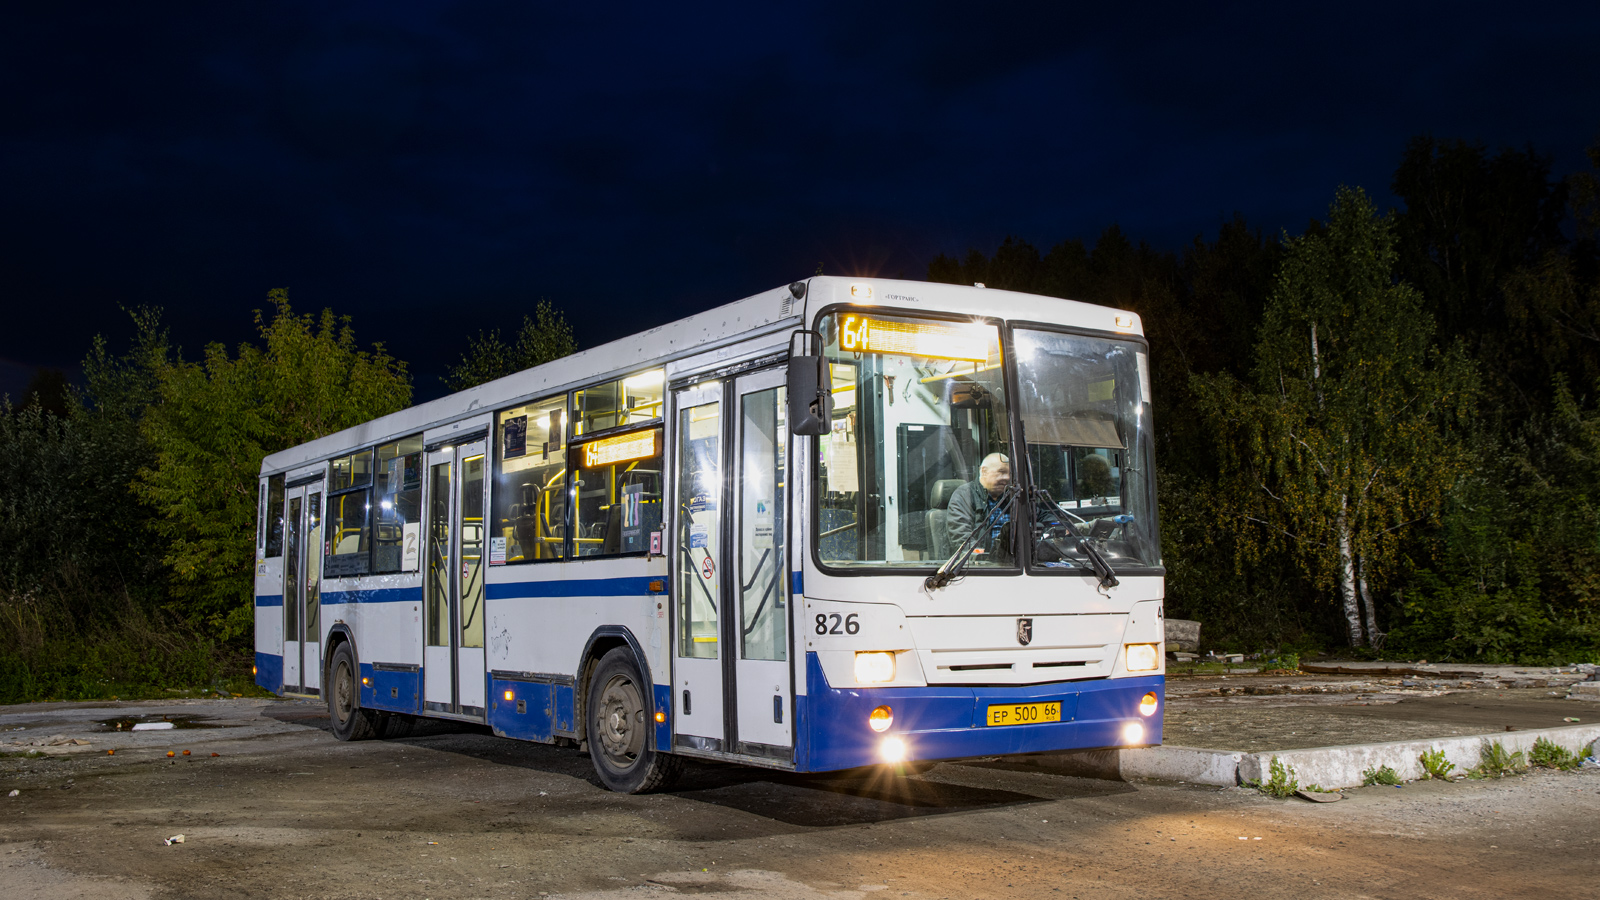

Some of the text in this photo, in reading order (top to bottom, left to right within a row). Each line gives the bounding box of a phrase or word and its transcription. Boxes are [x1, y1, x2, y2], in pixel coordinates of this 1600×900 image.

[843, 316, 868, 350] 64
[586, 441, 598, 467] 64
[405, 532, 417, 555] 2
[815, 613, 860, 636] 826
[1014, 705, 1038, 722] 500
[1044, 703, 1057, 716] 66
